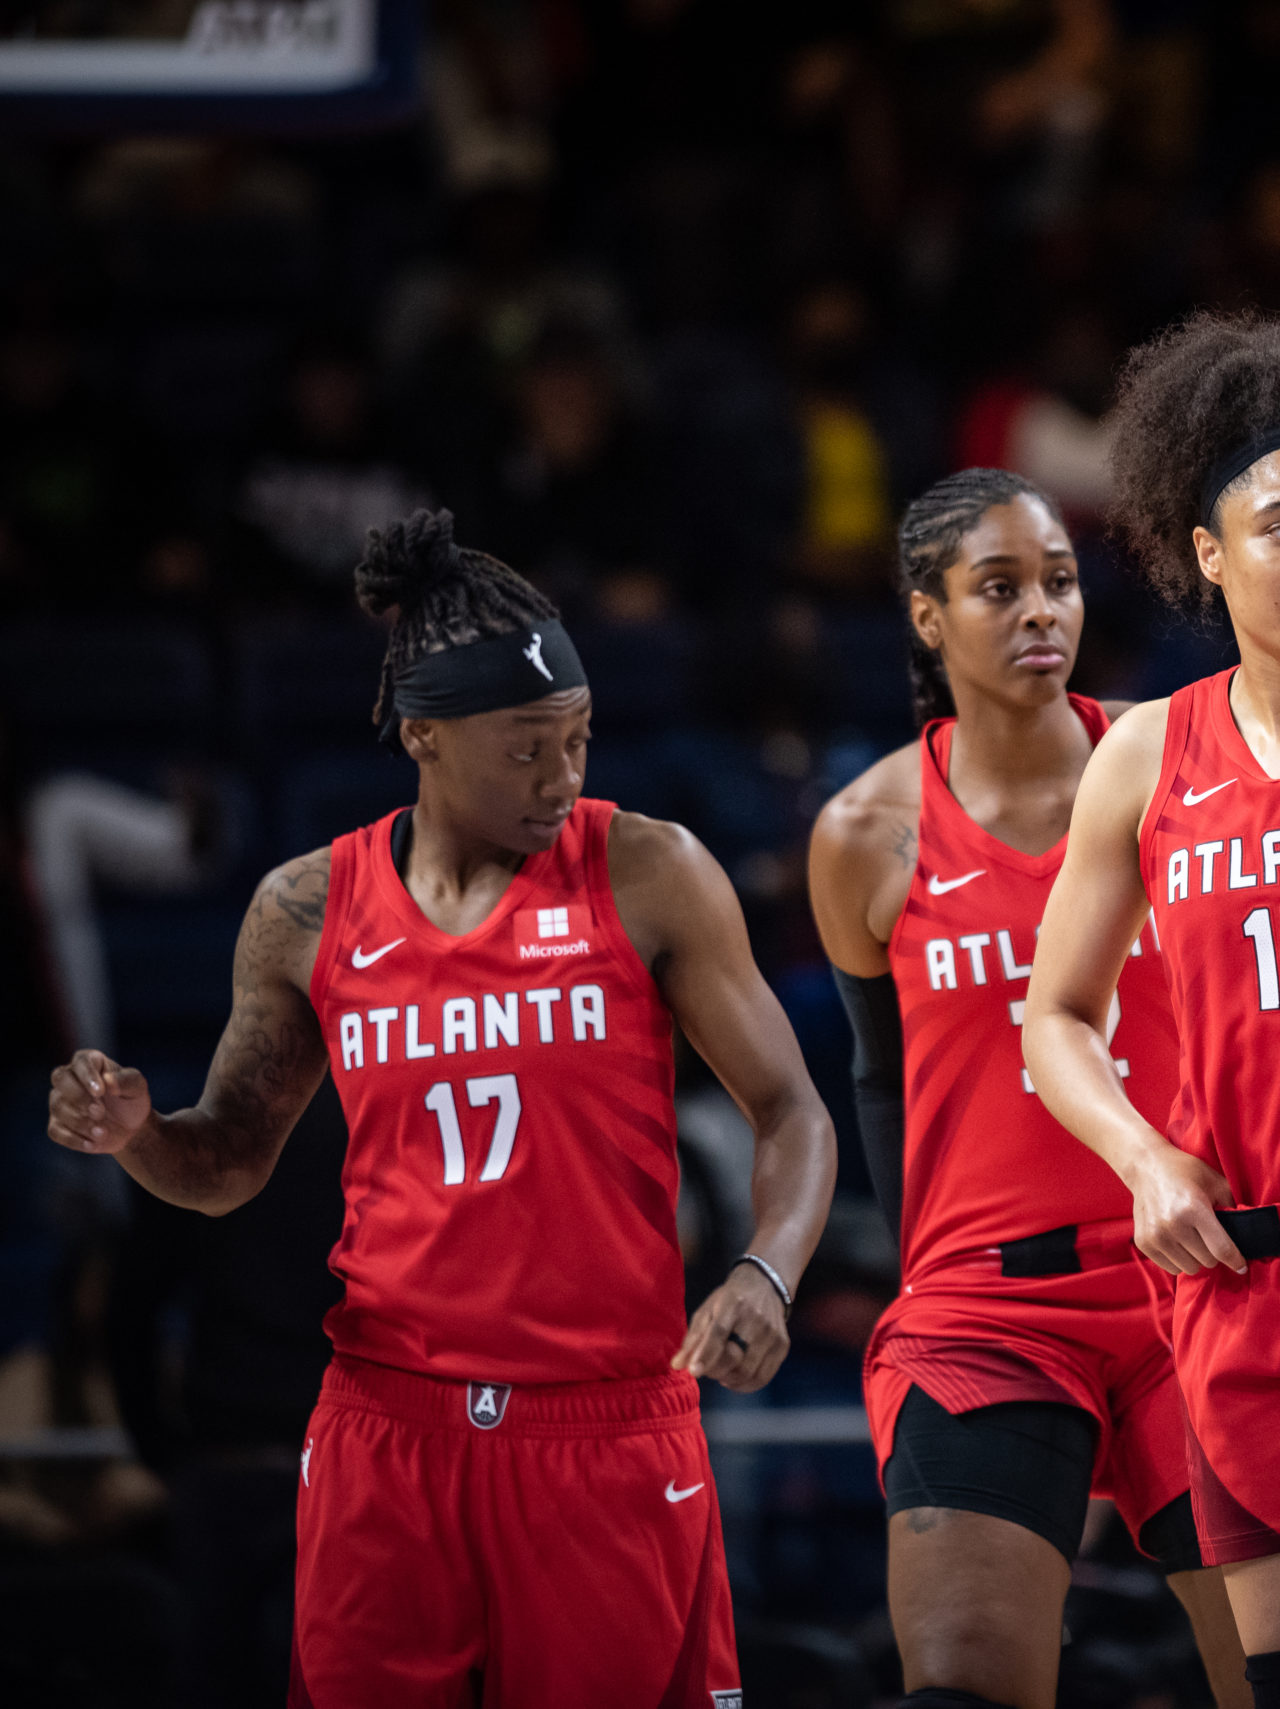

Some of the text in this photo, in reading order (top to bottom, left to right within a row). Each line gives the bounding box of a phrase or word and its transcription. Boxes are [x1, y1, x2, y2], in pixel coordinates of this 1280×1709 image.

[519, 939, 590, 960] Microsoft
[340, 984, 607, 1071] ATLANTA
[424, 1073, 522, 1186] 17
